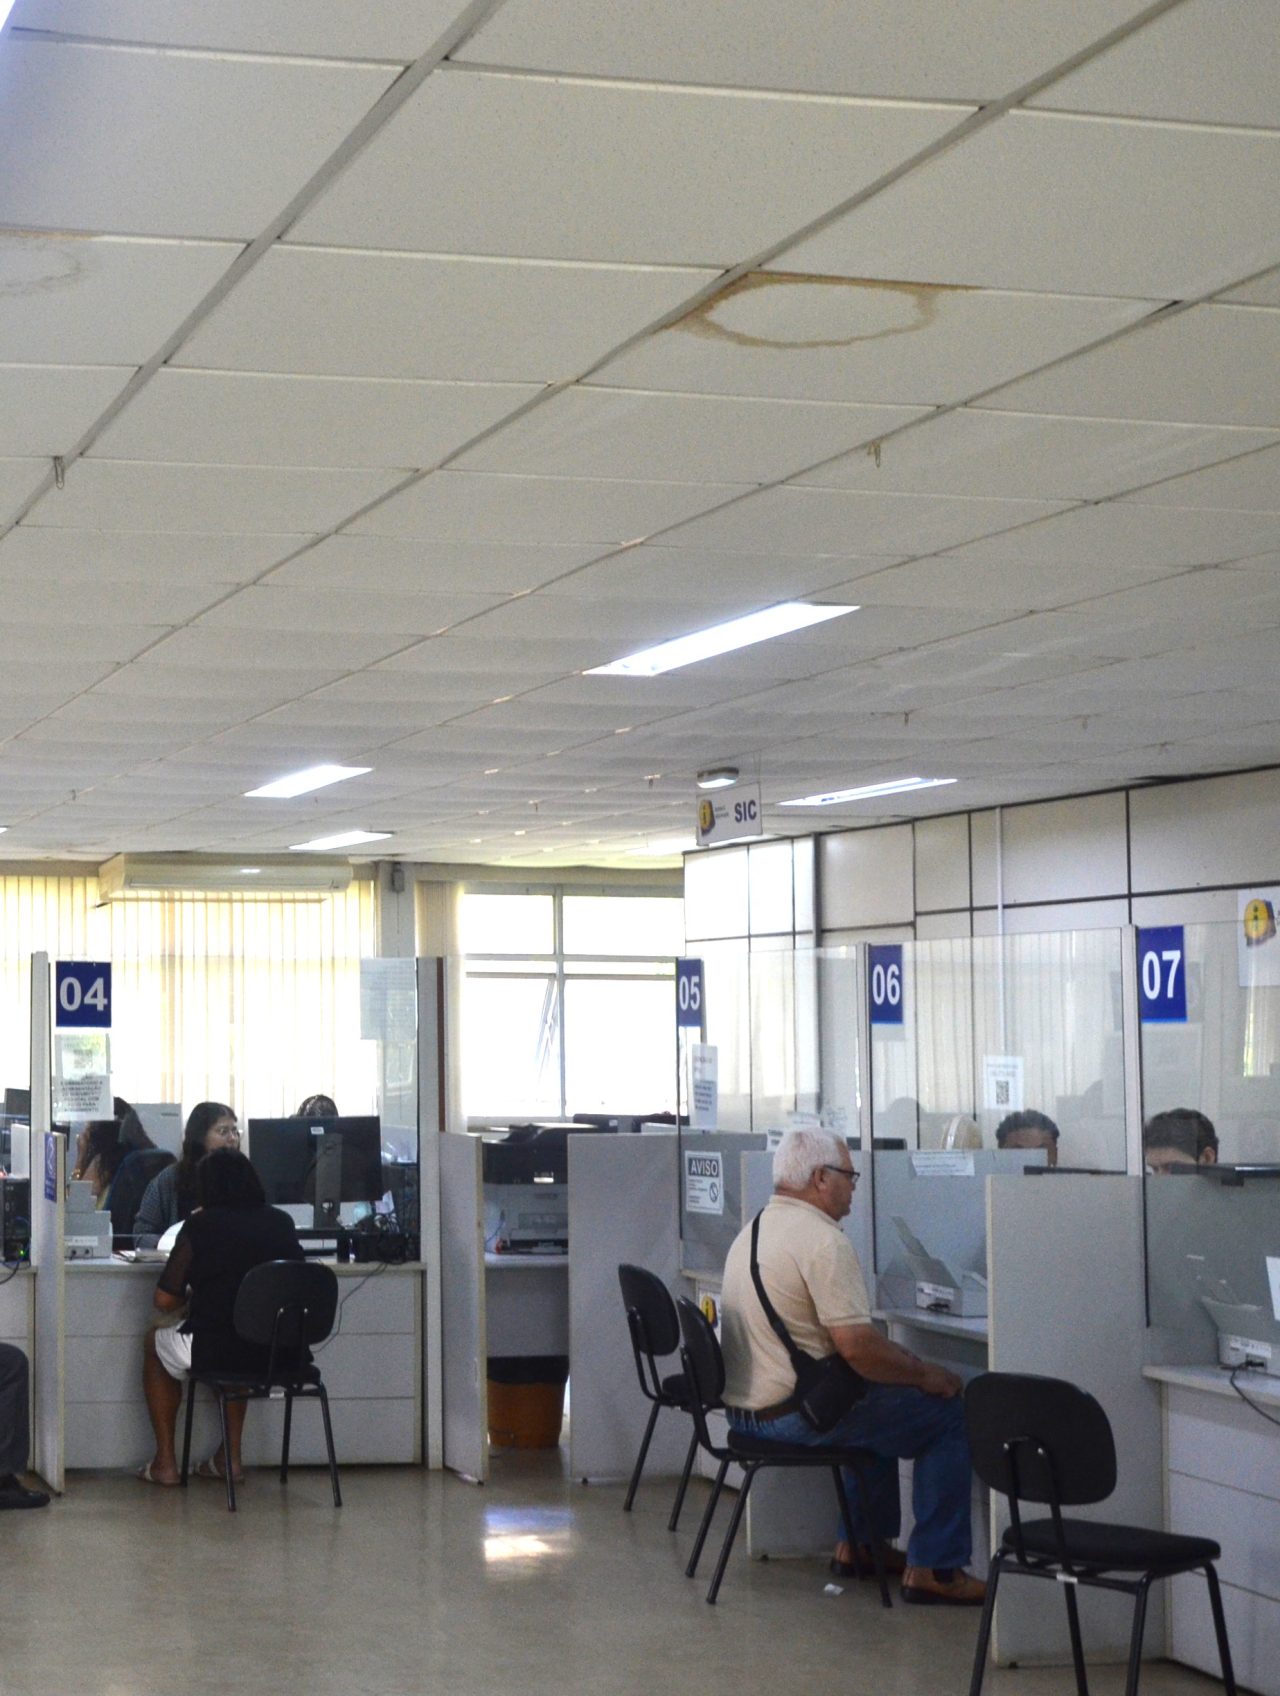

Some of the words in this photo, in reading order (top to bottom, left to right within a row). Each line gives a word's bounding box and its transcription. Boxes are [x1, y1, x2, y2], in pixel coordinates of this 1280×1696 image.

[734, 799, 757, 823] SIC
[679, 975, 700, 1010] 05
[872, 963, 900, 1005] 06
[1142, 950, 1181, 1000] 07
[60, 976, 108, 1011] 04
[690, 1159, 718, 1176] AVISO
